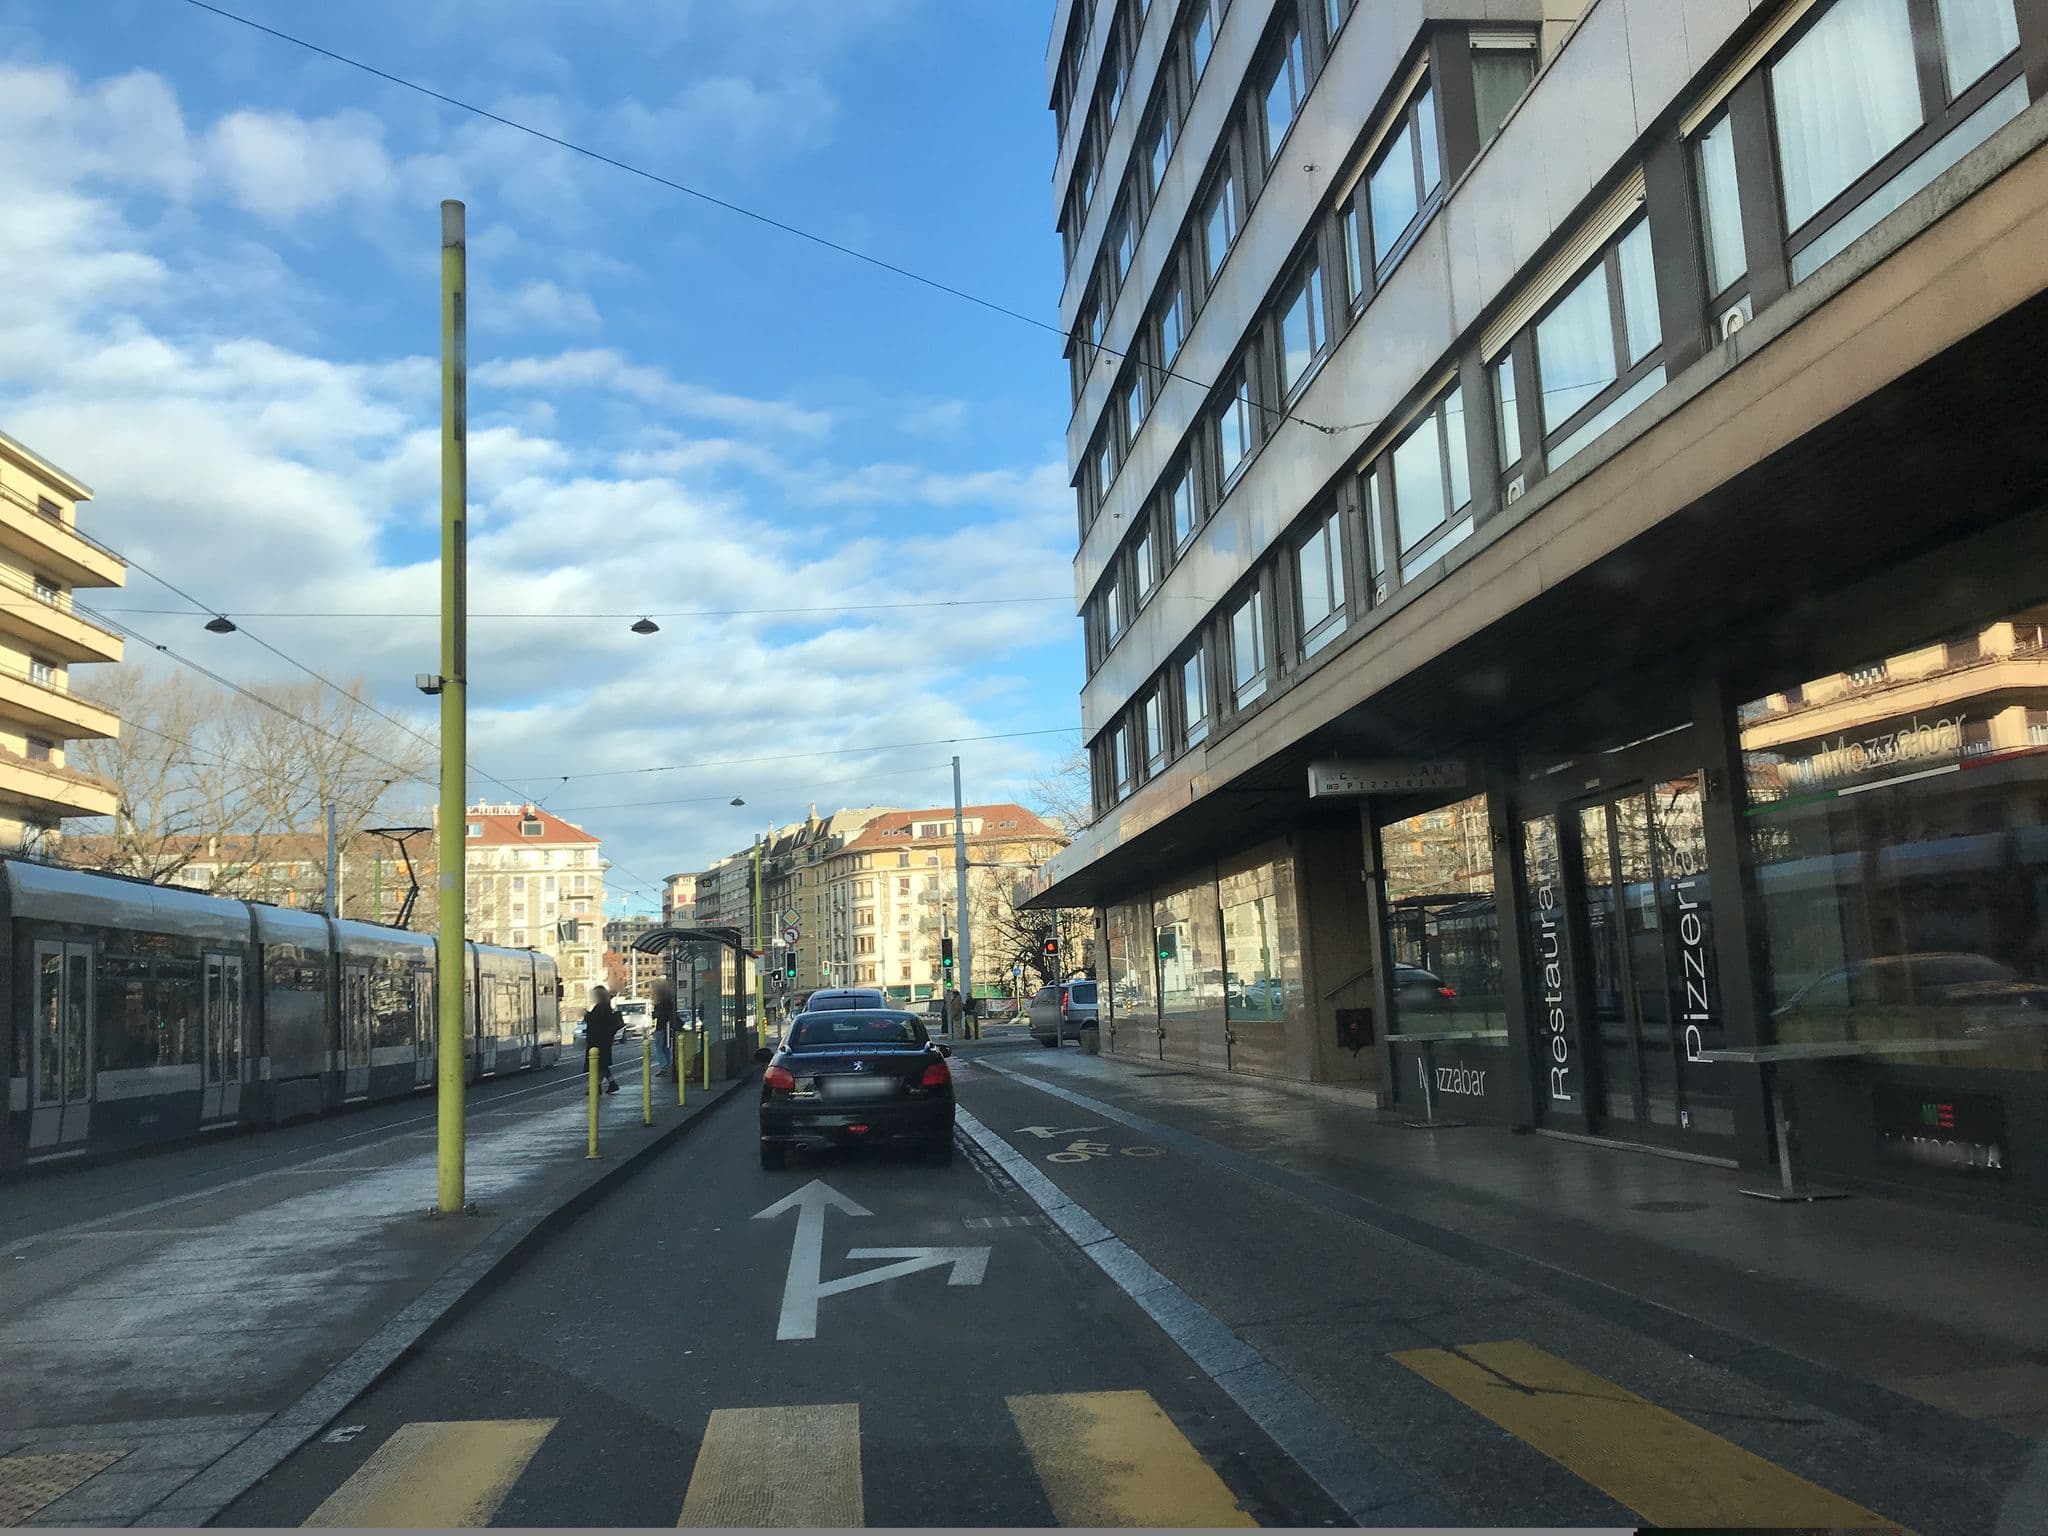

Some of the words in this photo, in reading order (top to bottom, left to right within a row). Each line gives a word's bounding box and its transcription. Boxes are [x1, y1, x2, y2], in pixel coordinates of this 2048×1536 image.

[1821, 713, 1966, 778] Mozzabar
[466, 805, 521, 816] EJOURNE
[1671, 846, 1713, 1063] Pizzeria
[1418, 1057, 1486, 1096] Mzzabar
